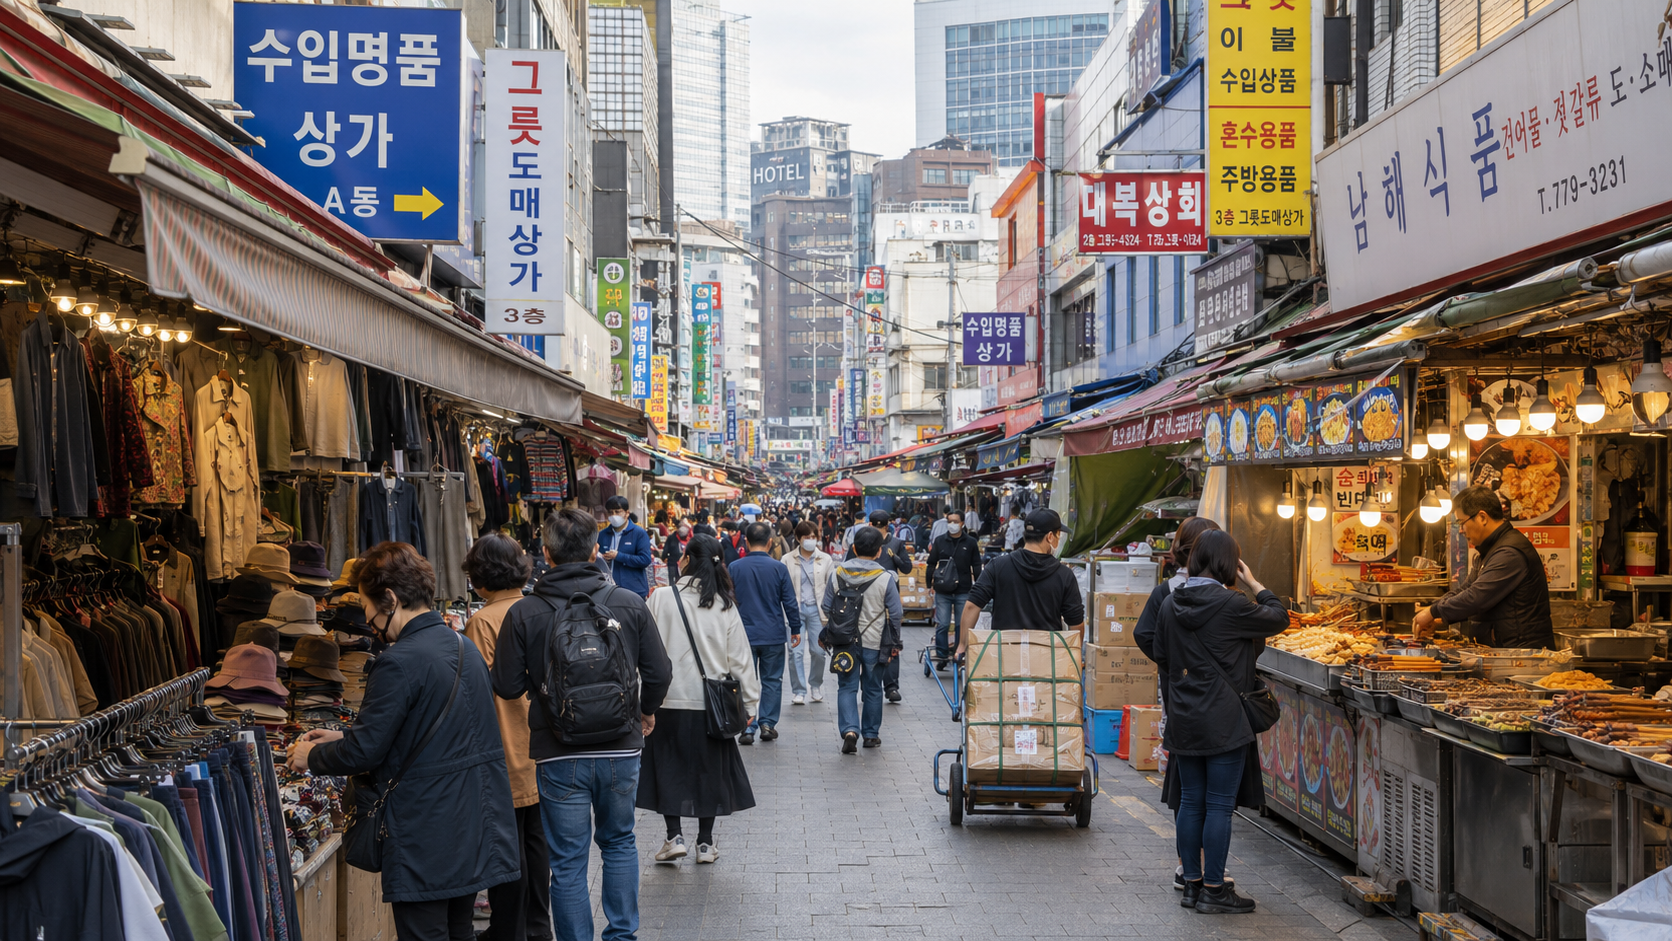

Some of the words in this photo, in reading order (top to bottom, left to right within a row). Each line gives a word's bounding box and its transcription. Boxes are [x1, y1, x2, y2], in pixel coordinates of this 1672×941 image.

[247, 28, 441, 87] 수입명품
[1220, 68, 1296, 94] 수입상품
[293, 111, 393, 169] 상가
[1220, 121, 1296, 149] 혼수용품
[508, 60, 542, 292] 그릇도매상가
[753, 163, 805, 185] HOTEL
[1220, 165, 1297, 193] 주방용품
[1537, 155, 1626, 214] T.779-3231
[323, 186, 380, 218] A동
[1082, 181, 1201, 227] 대복상회
[1215, 209, 1235, 226] 3층
[503, 307, 546, 325] 3층
[965, 317, 1022, 337] 수입명품
[976, 341, 1013, 362] 상가
